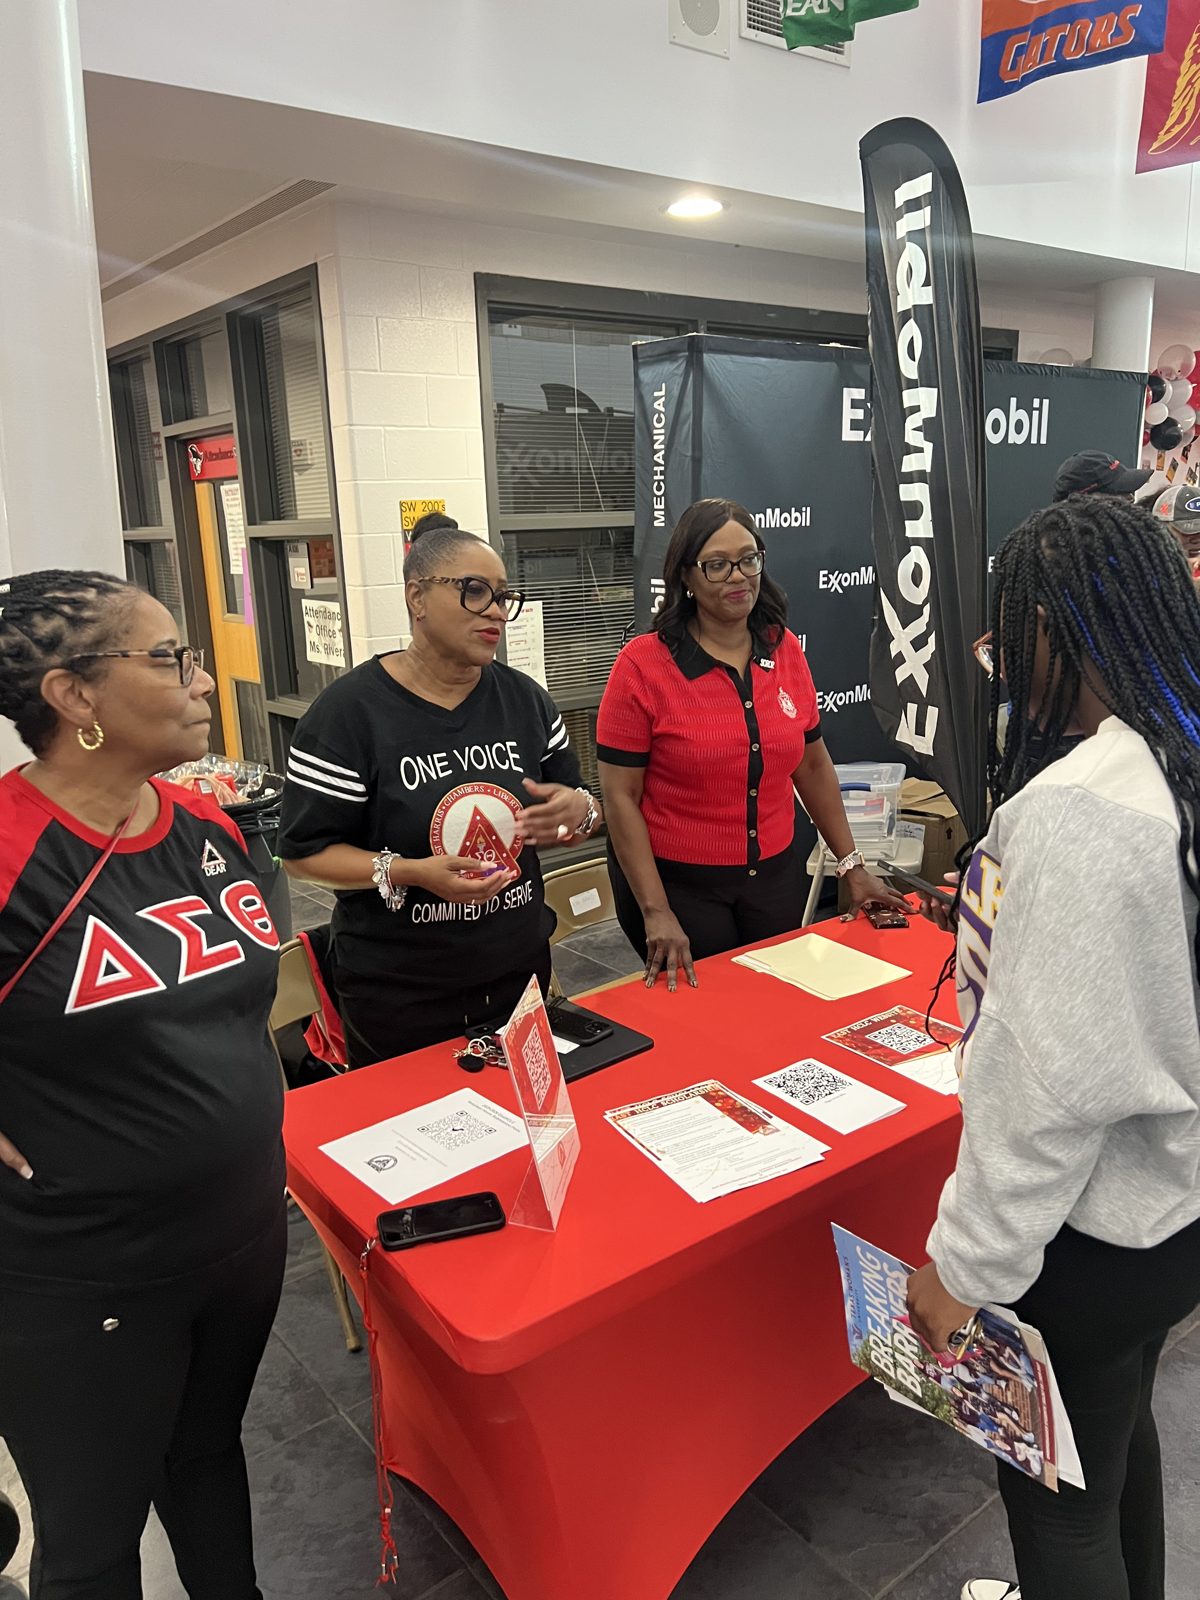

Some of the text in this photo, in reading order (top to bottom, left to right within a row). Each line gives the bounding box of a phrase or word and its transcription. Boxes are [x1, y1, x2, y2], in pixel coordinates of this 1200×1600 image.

[999, 4, 1142, 83] GATORS
[653, 382, 666, 527] MECHANICAL
[401, 500, 446, 513] SW 200's
[304, 605, 341, 620] Attendanc
[315, 624, 337, 639] Office
[309, 640, 322, 655] Ms.
[400, 741, 524, 791] ONE VOICE
[432, 808, 445, 842] HARRIS
[444, 785, 485, 807] CHAMBERS
[204, 863, 227, 877] DEAR
[503, 880, 533, 910] SERVE
[856, 1245, 895, 1380] BREAKING
